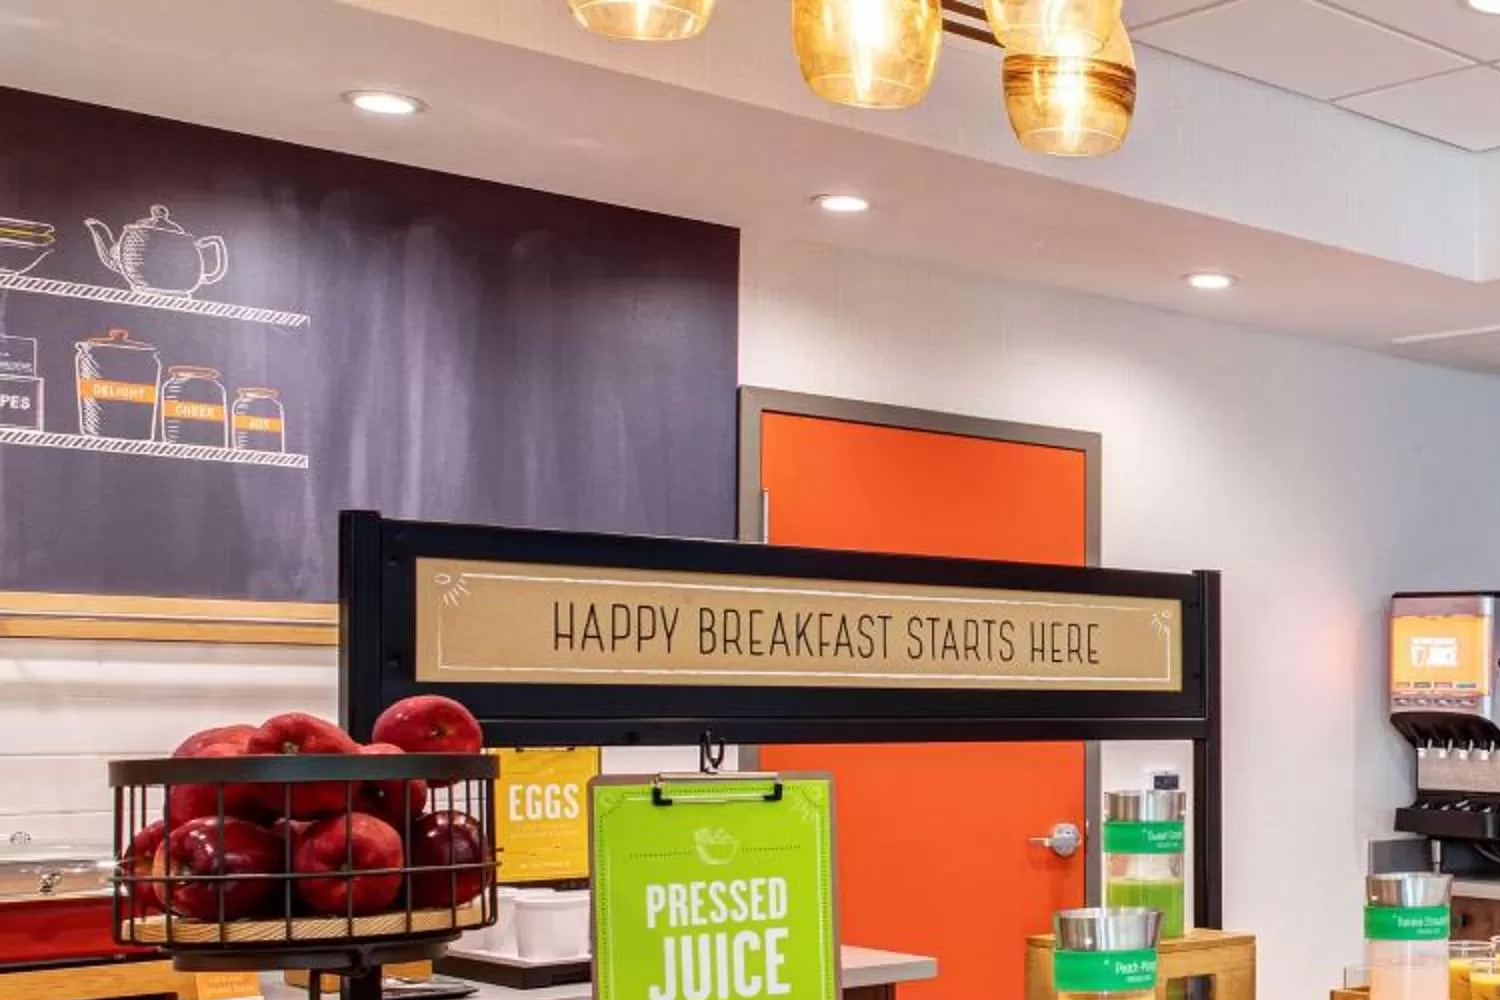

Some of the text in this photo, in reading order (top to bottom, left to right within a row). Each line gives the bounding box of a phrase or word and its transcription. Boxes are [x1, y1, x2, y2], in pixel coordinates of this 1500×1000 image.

[92, 384, 146, 400] DELIGHT
[553, 600, 1101, 665] HAPPY BREAKFAST STARTS HERE
[508, 783, 580, 822] EGGS
[646, 877, 788, 929] PRESSED
